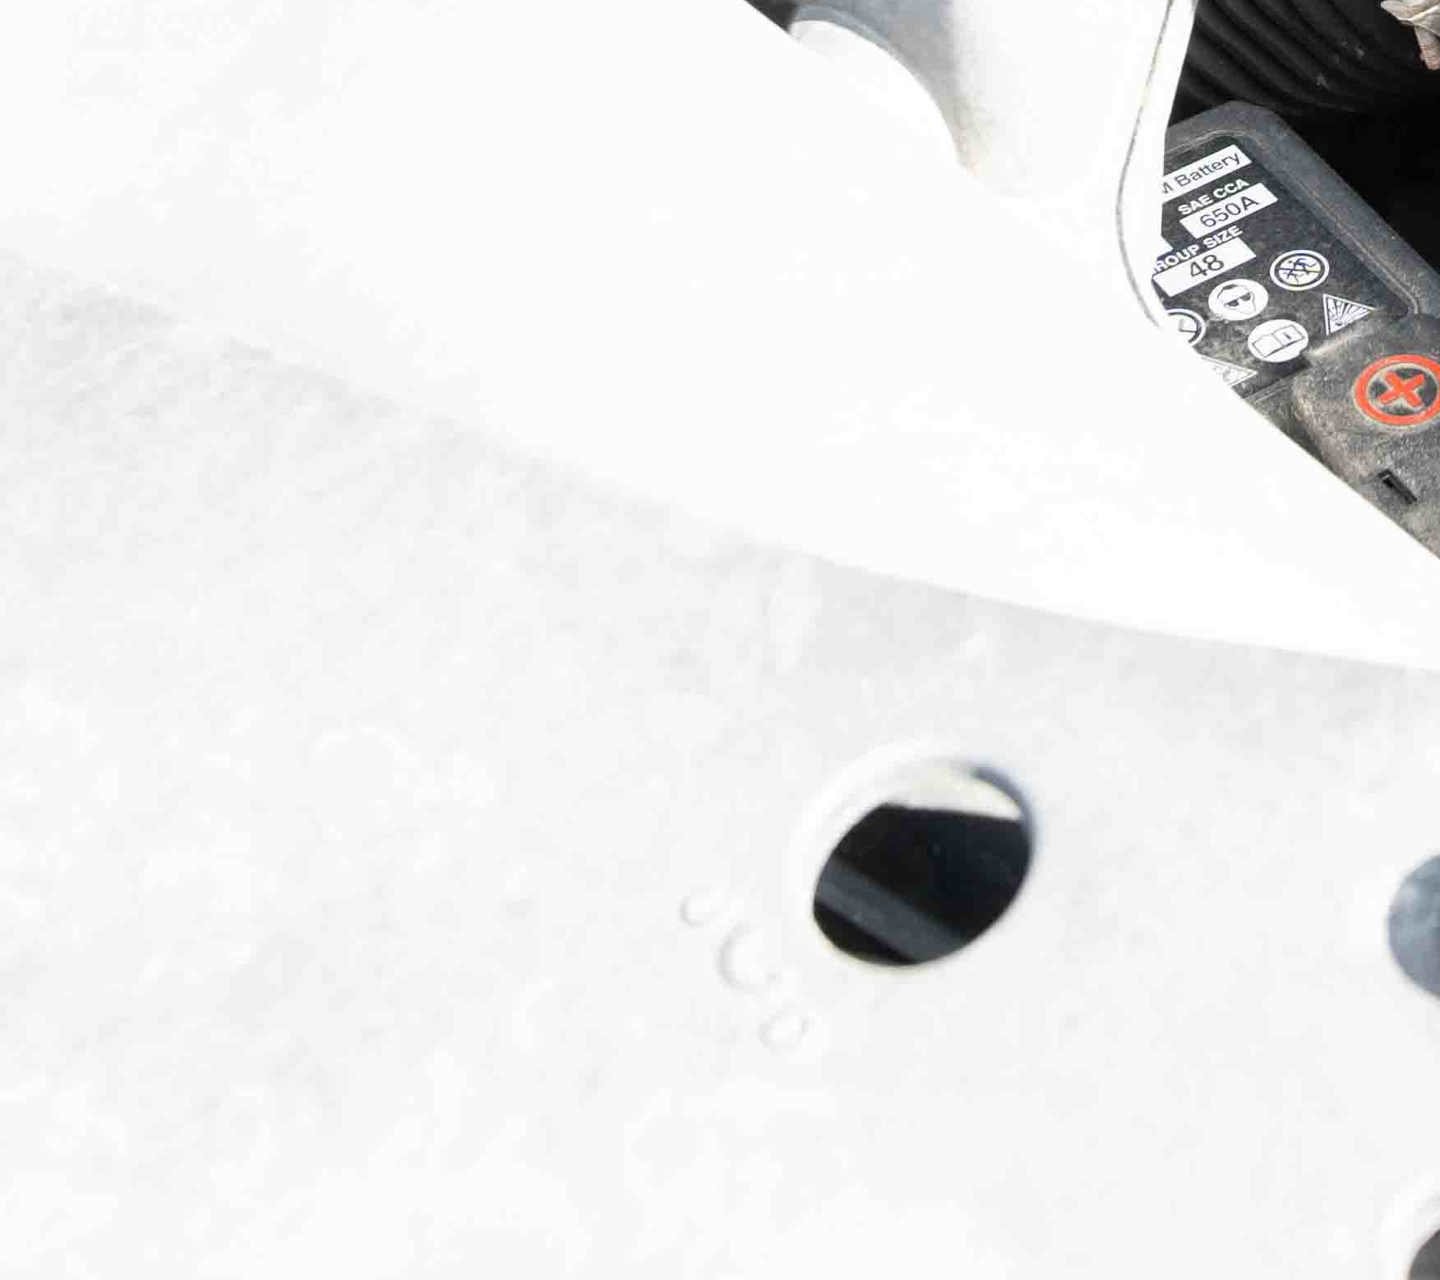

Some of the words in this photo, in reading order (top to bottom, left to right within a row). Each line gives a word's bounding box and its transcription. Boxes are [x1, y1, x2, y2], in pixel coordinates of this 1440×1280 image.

[1174, 151, 1241, 187] Battery
[1177, 195, 1213, 216] SAE
[1213, 178, 1251, 199] CCA
[1199, 195, 1260, 228] 650A
[1152, 243, 1201, 274] ROUP
[1203, 224, 1244, 249] SIZE
[1190, 253, 1225, 278] 48
